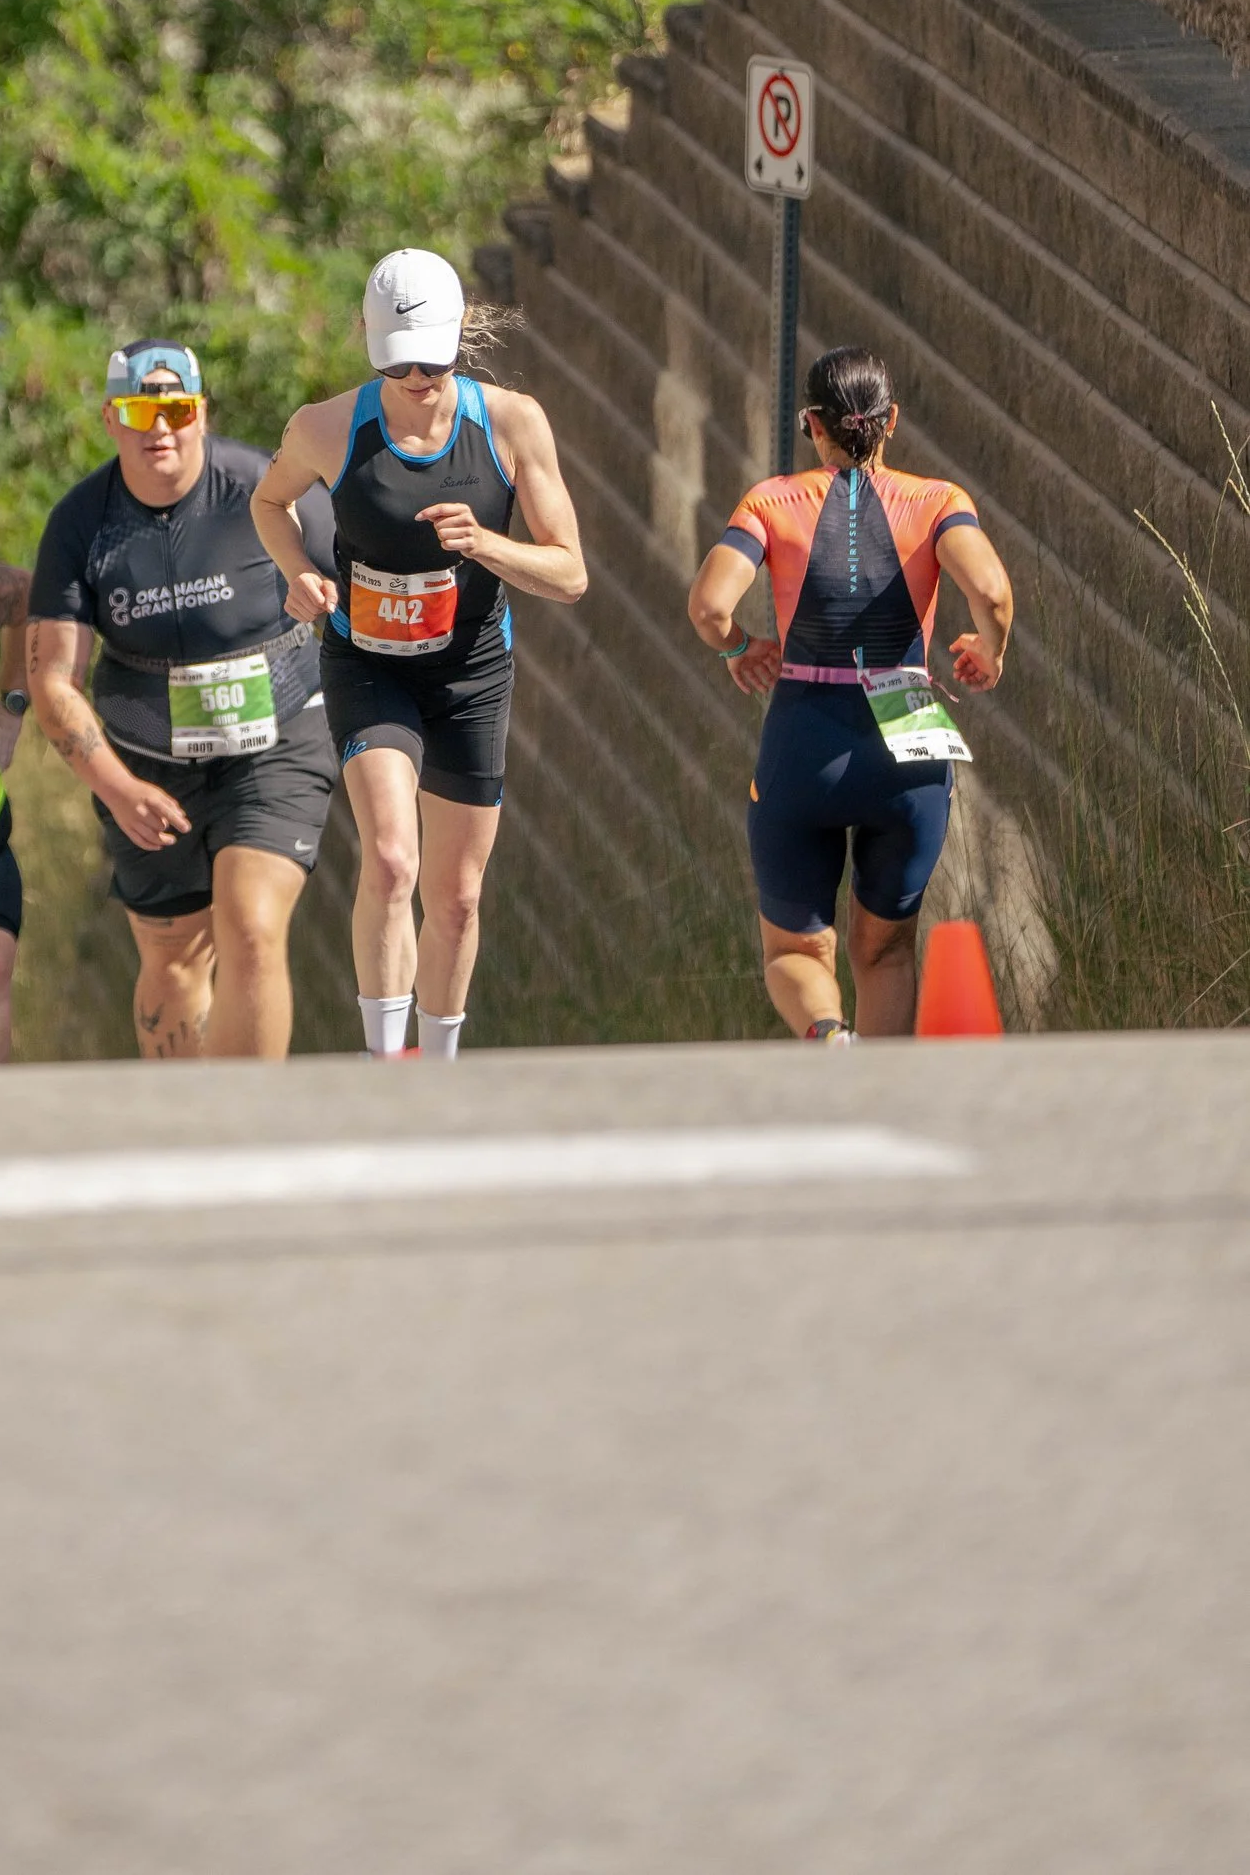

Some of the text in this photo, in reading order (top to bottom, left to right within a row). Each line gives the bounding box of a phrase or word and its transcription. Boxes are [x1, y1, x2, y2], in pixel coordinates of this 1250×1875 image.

[439, 473, 480, 489] Santic
[848, 512, 858, 594] VAN RYSEL
[367, 577, 382, 587] 2025
[377, 597, 424, 625] 442
[200, 682, 245, 713] 560
[188, 735, 268, 754] FOOD DRINK
